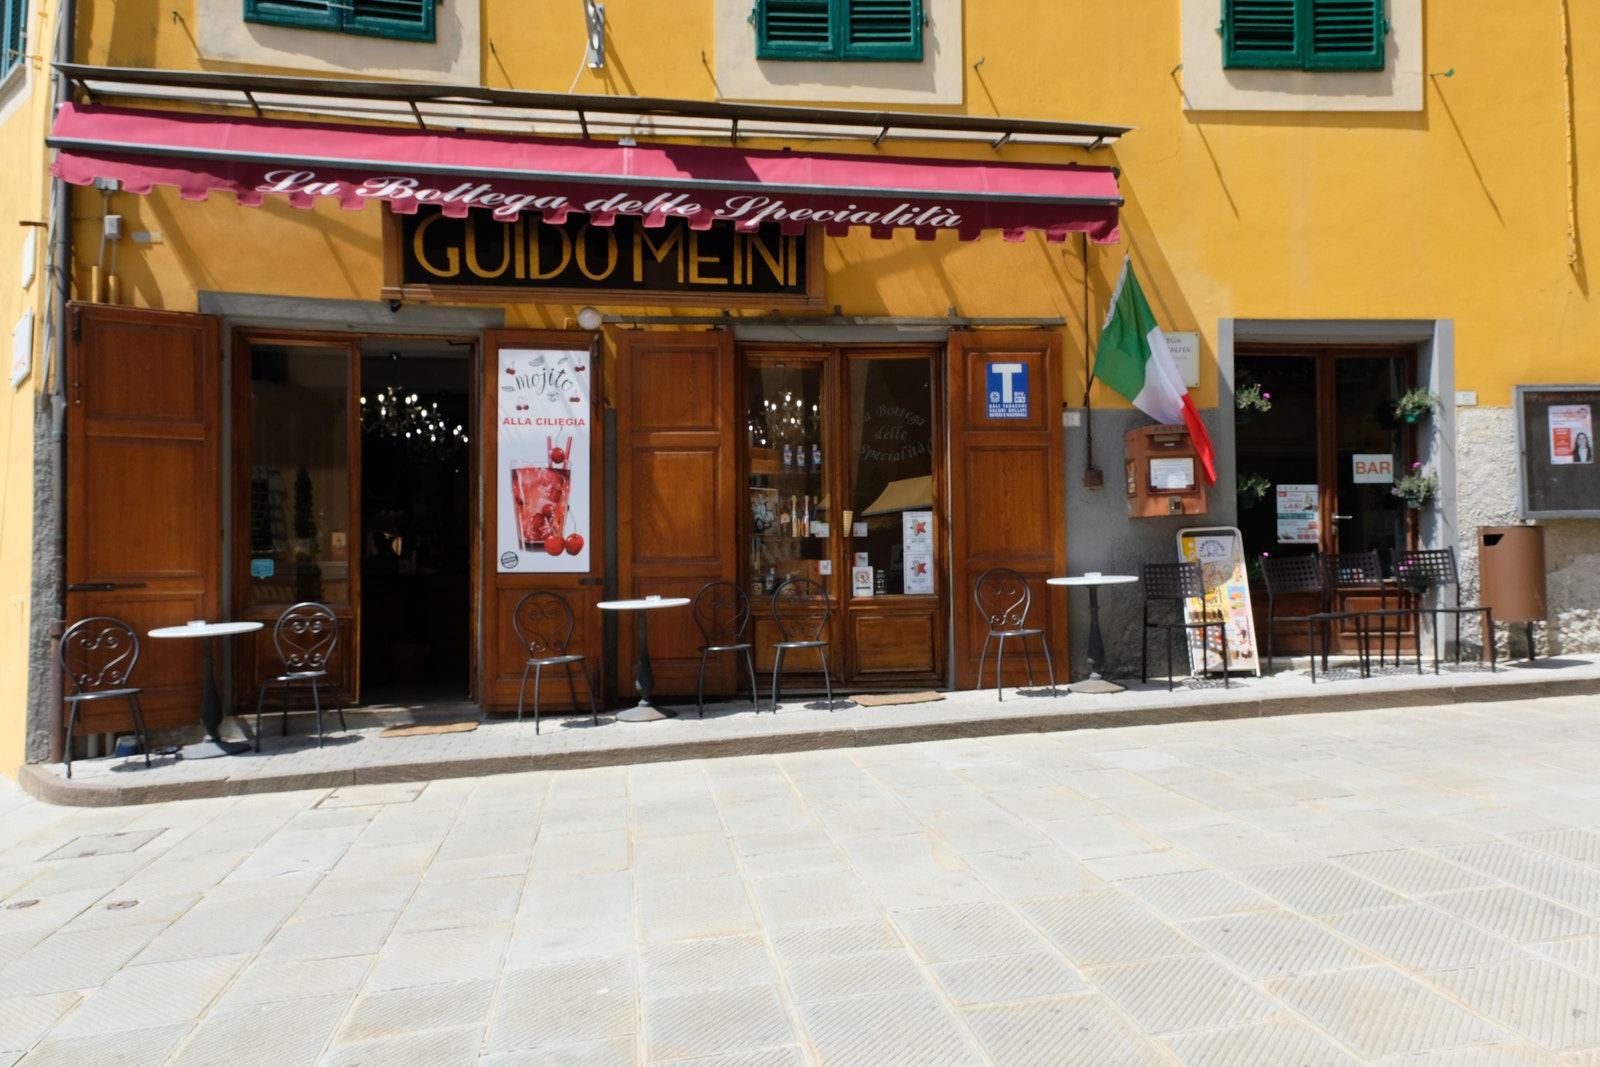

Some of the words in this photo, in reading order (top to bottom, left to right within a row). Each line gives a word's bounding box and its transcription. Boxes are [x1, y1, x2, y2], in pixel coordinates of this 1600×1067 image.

[255, 169, 342, 196] La
[355, 176, 569, 216] Bottega
[583, 192, 702, 216] delle
[713, 195, 964, 228] Specialità
[413, 209, 618, 281] GUIDO
[632, 218, 798, 287] MEINI
[515, 367, 574, 396] mojito
[991, 363, 1023, 404] T
[502, 417, 532, 426] ALLA
[535, 417, 586, 427] CILIEGIA
[876, 404, 927, 427] Bottega
[873, 425, 908, 441] delle
[1355, 461, 1392, 475] BAR
